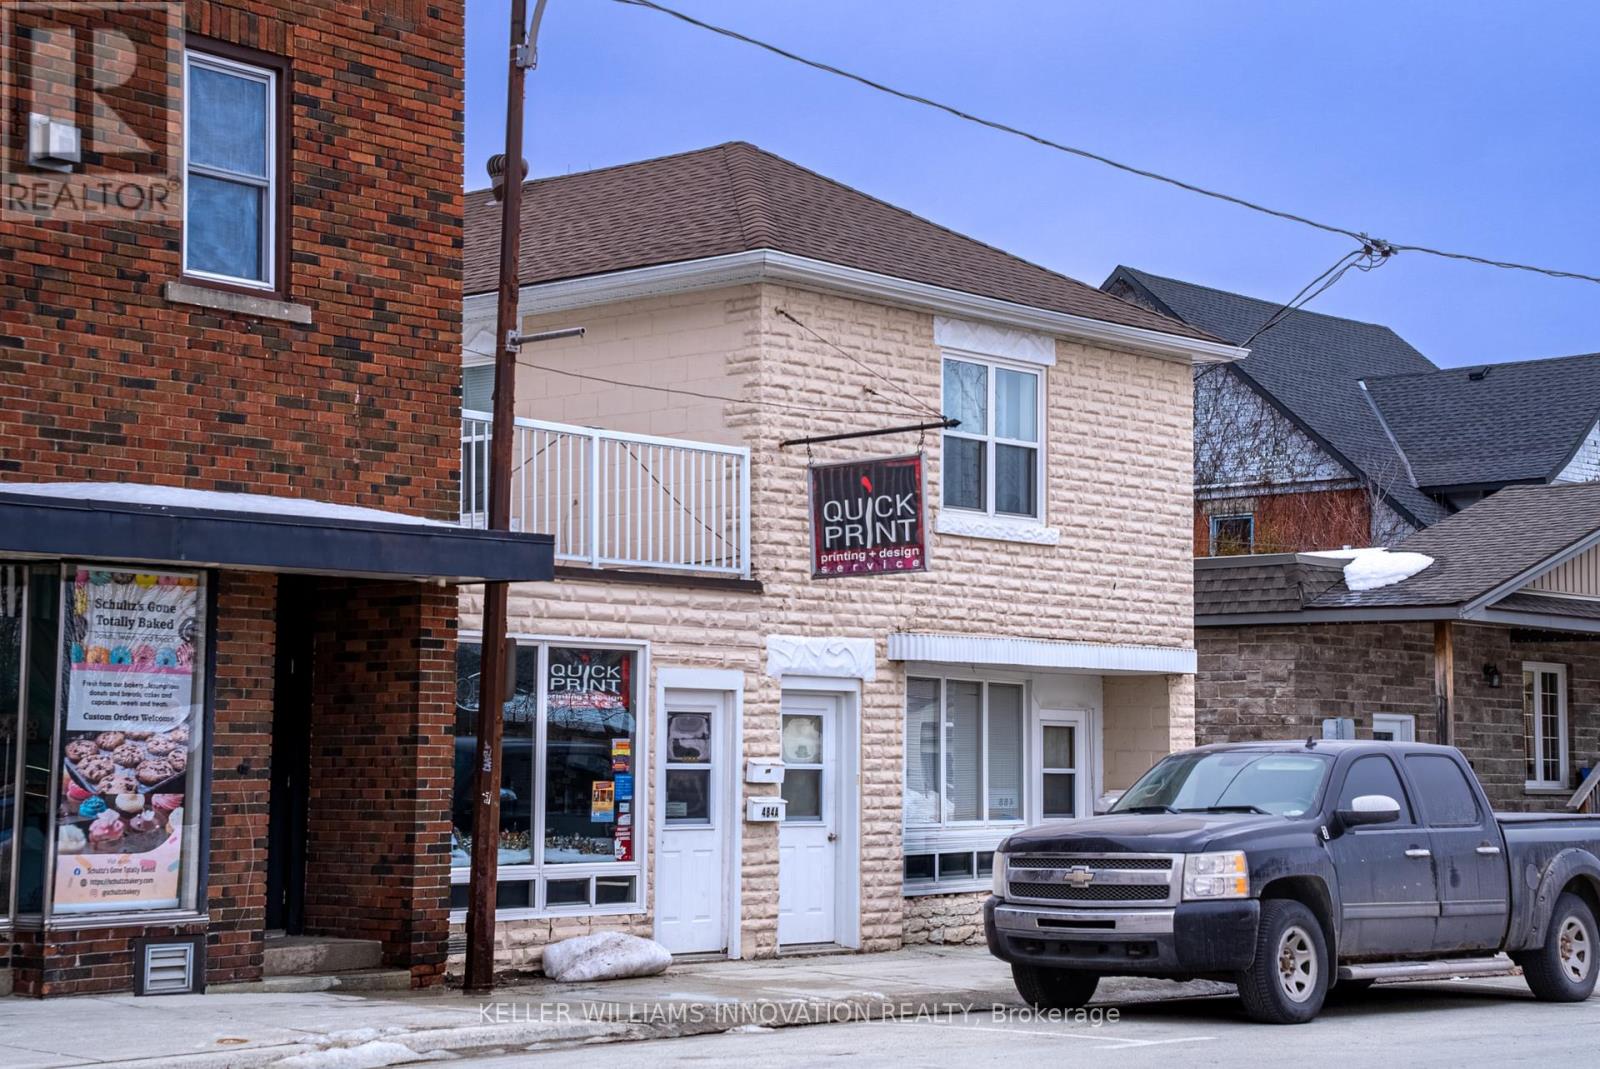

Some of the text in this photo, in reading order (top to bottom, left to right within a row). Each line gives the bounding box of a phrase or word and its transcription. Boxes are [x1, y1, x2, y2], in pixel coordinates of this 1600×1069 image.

[823, 493, 915, 522] QUICK
[824, 519, 916, 549] PRINT
[821, 551, 866, 564] printing
[879, 547, 920, 558] design
[821, 559, 920, 574] service
[95, 598, 177, 613] Schultz's Gone
[96, 615, 174, 630] Totally Baked
[551, 663, 621, 678] QUICK
[550, 678, 621, 693] PRINT
[83, 712, 175, 723] Custom Orders Welcome
